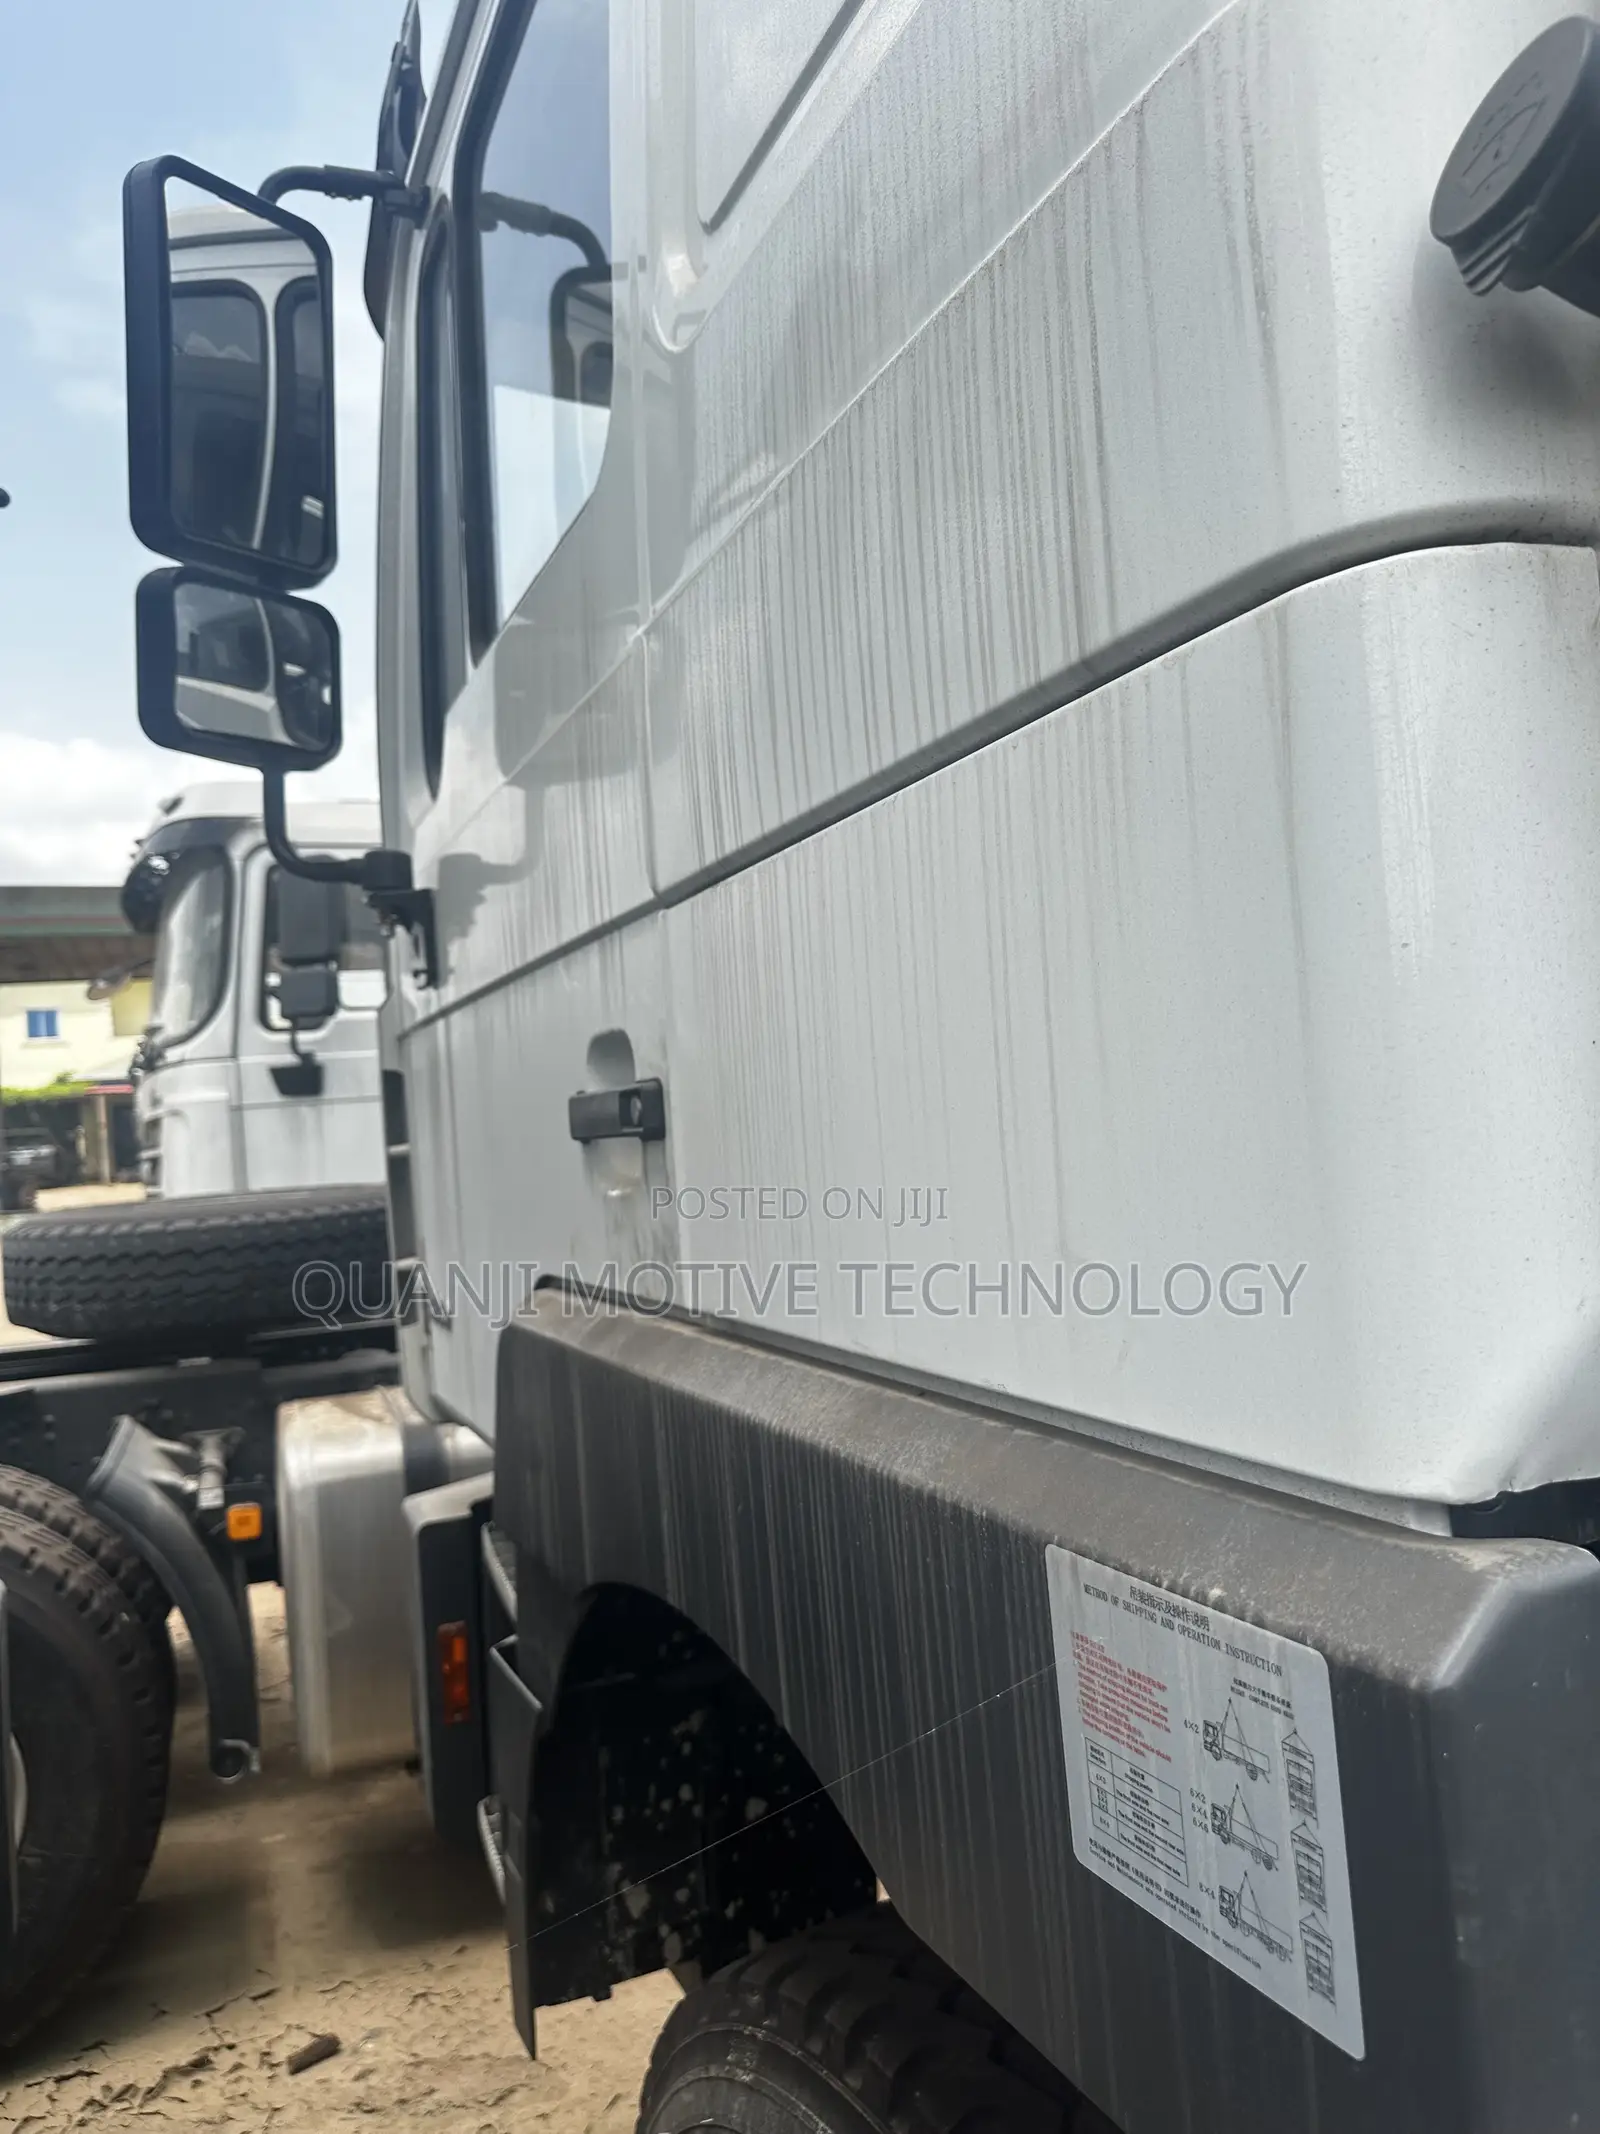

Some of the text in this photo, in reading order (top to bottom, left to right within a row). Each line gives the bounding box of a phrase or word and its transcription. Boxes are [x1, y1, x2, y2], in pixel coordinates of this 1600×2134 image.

[1122, 1600, 1157, 1624] SHIPPING
[1160, 1616, 1175, 1632] AND
[1177, 1624, 1221, 1651] OPERATION
[1224, 1643, 1283, 1677] INSTRUCTION
